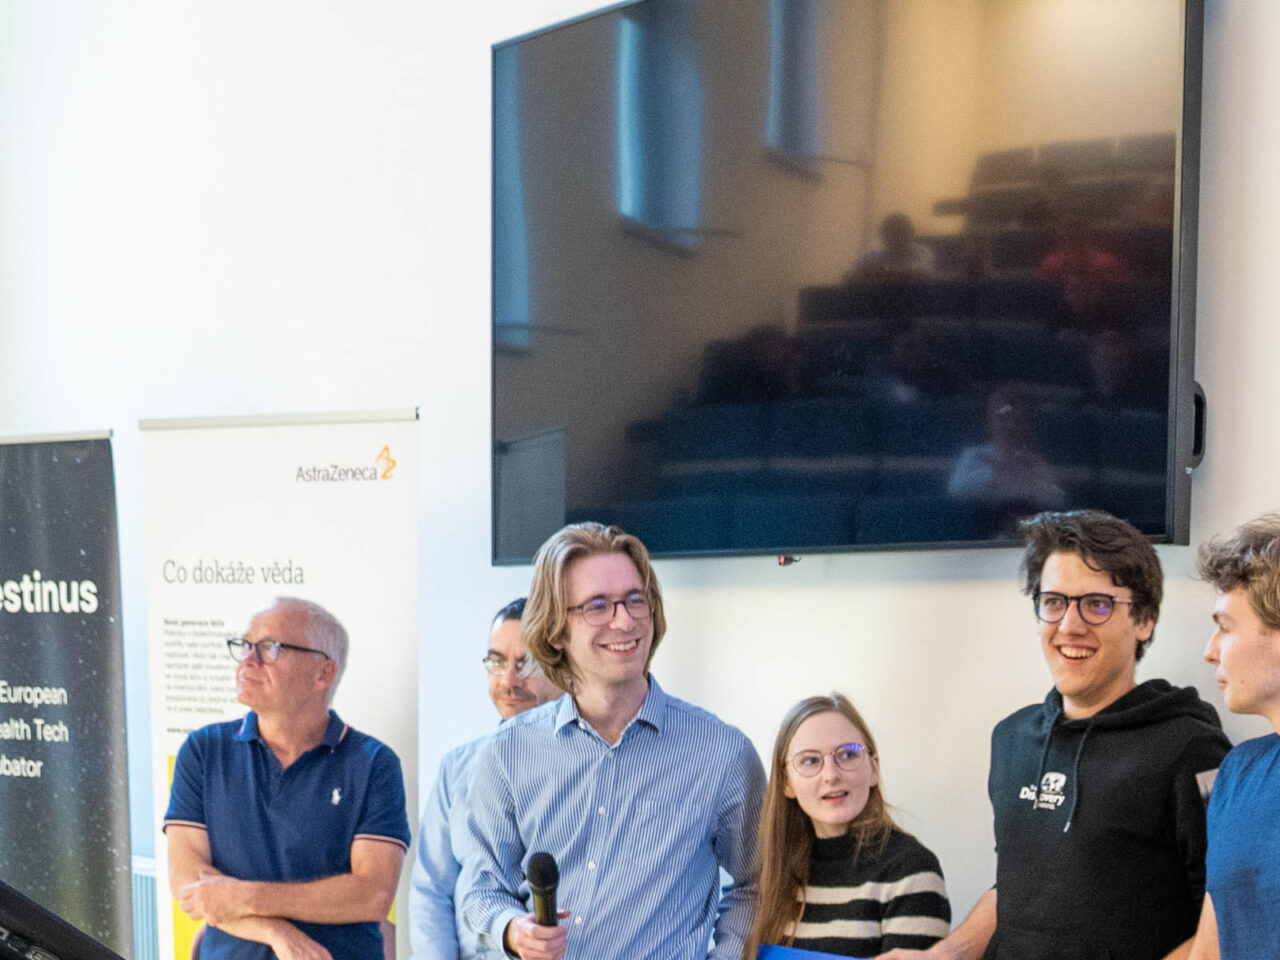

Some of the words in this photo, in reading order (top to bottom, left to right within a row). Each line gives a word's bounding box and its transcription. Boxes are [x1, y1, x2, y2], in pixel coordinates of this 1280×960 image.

[296, 465, 378, 482] AstraZeneca
[162, 558, 188, 585] Co
[192, 558, 256, 585] dokáže
[261, 558, 305, 585] věda
[0, 569, 99, 614] stinus
[0, 680, 68, 708] European
[32, 718, 70, 743] Tech
[0, 754, 43, 778] bator
